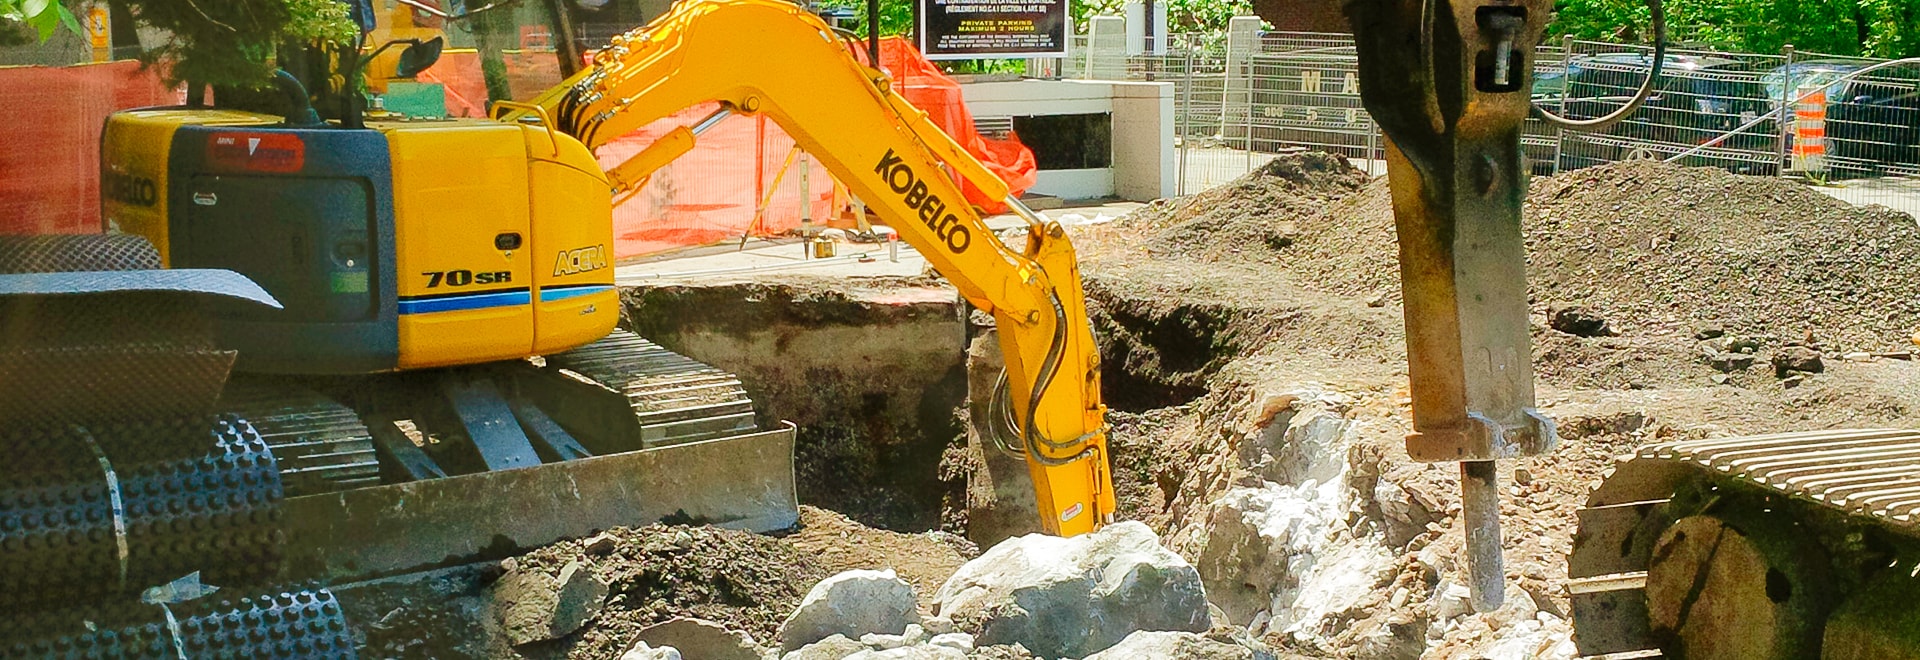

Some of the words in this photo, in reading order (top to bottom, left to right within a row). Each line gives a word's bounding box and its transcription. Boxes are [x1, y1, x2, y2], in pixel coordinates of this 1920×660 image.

[217, 137, 235, 145] MINI
[874, 147, 971, 254] KOBELCO
[553, 243, 608, 277] ACERA
